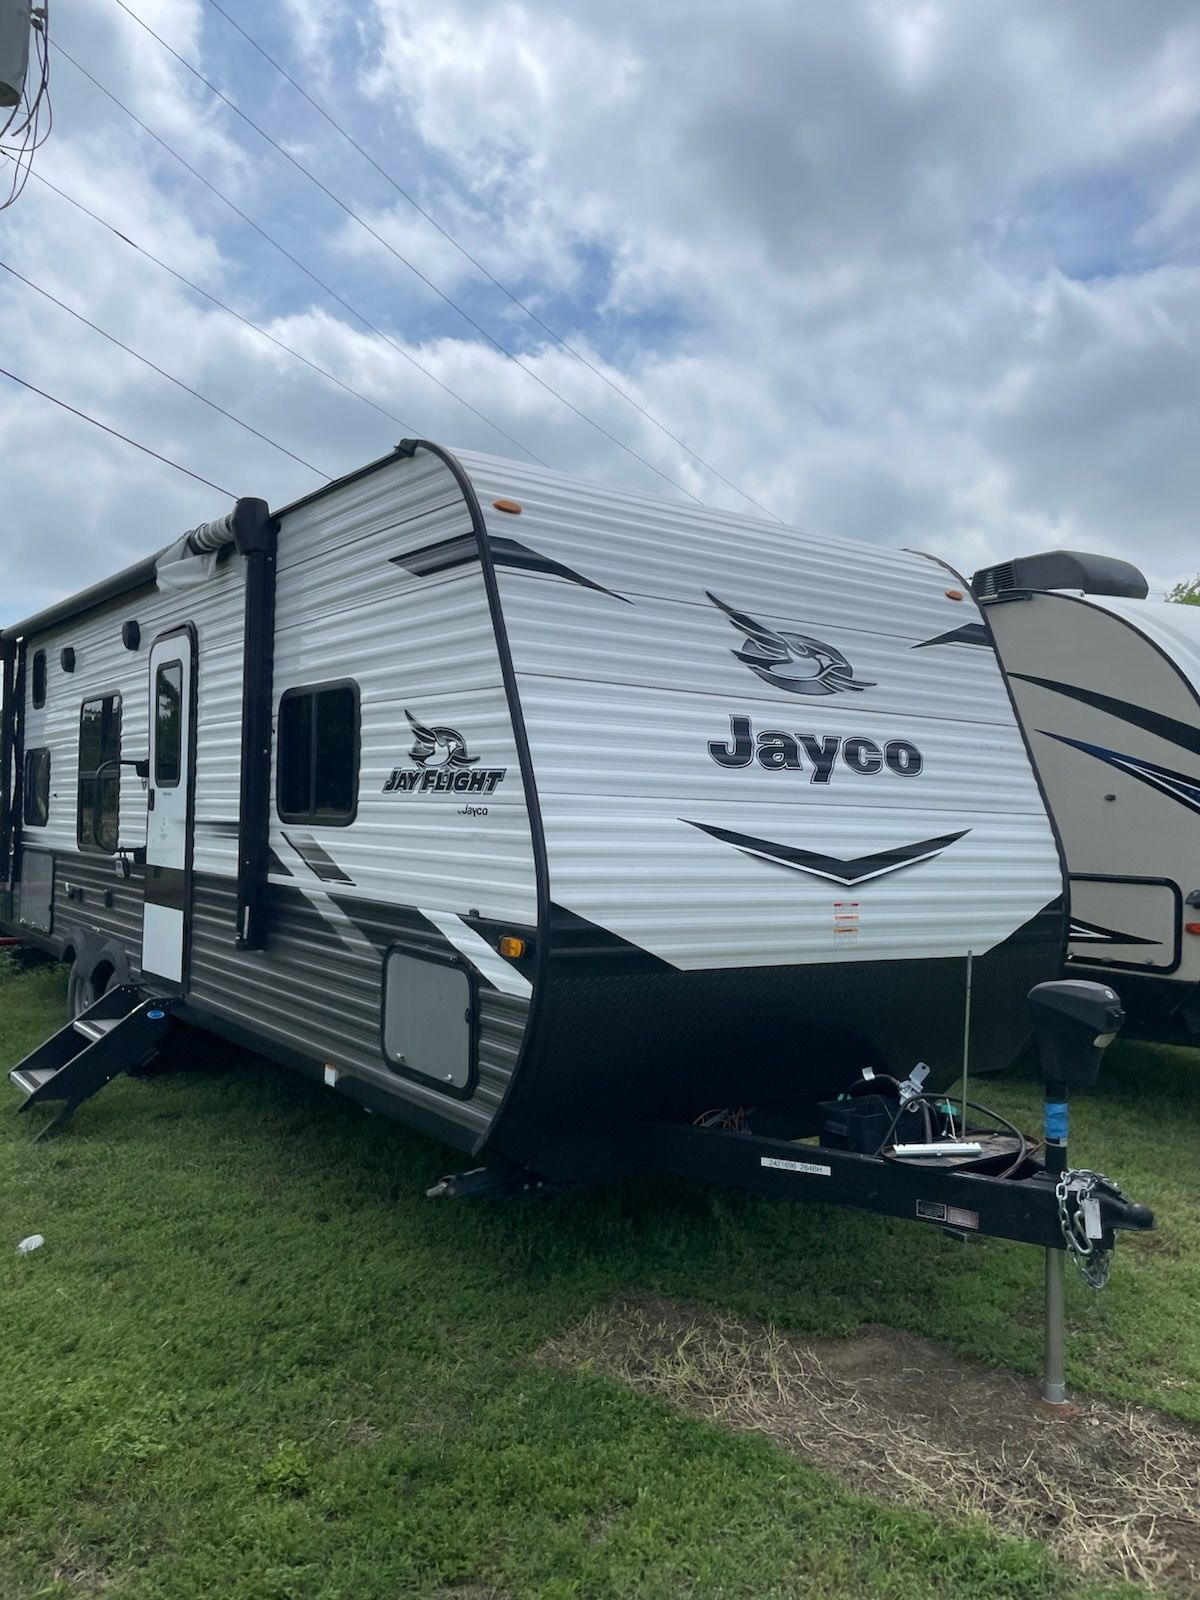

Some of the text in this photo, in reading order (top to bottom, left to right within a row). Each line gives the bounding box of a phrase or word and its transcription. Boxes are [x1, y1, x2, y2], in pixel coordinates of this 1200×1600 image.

[707, 714, 924, 785] Jayco
[382, 767, 507, 795] JAY FLIGHT
[462, 804, 488, 817] Jayco
